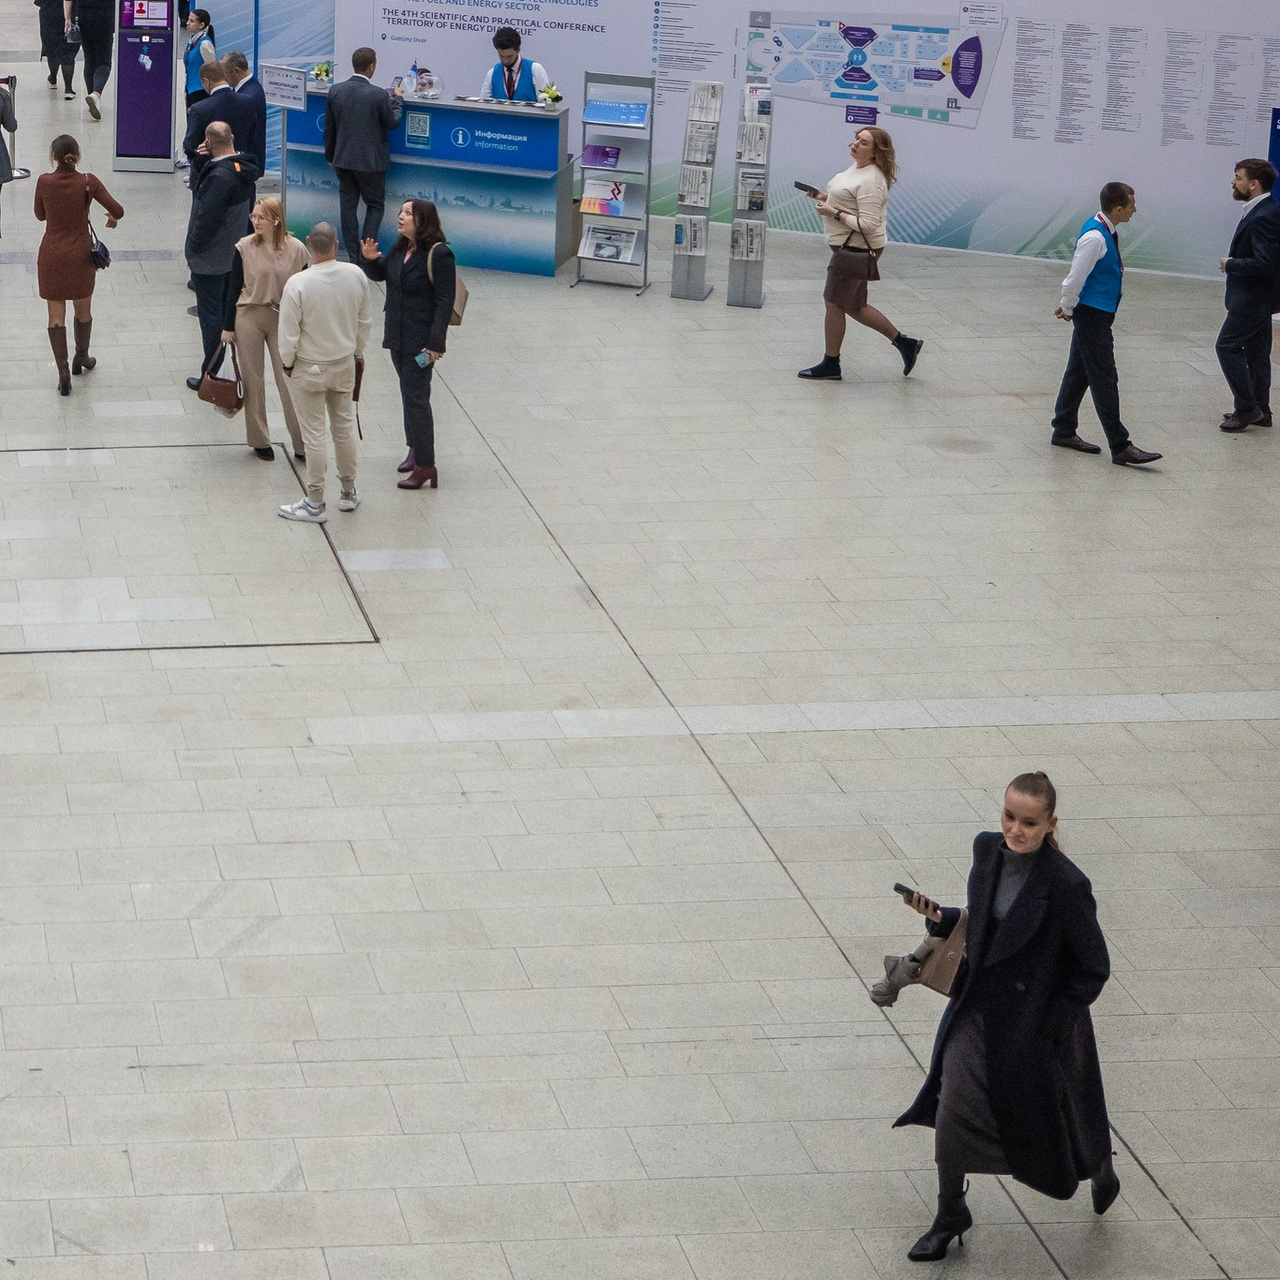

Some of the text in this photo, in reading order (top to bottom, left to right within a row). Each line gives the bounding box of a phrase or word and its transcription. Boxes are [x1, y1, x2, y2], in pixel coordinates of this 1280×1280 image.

[468, 0, 503, 9] ENERGY
[505, 1, 541, 11] SECTOR
[382, 8, 606, 33] THE 4TH SCIENTIFIC AND PRACTICAL CONFERENCE
[382, 16, 485, 32] "TERRITORY OF ENERGY
[391, 35, 413, 43] Gostiny
[475, 130, 527, 142] Информация
[475, 140, 518, 151] Information
